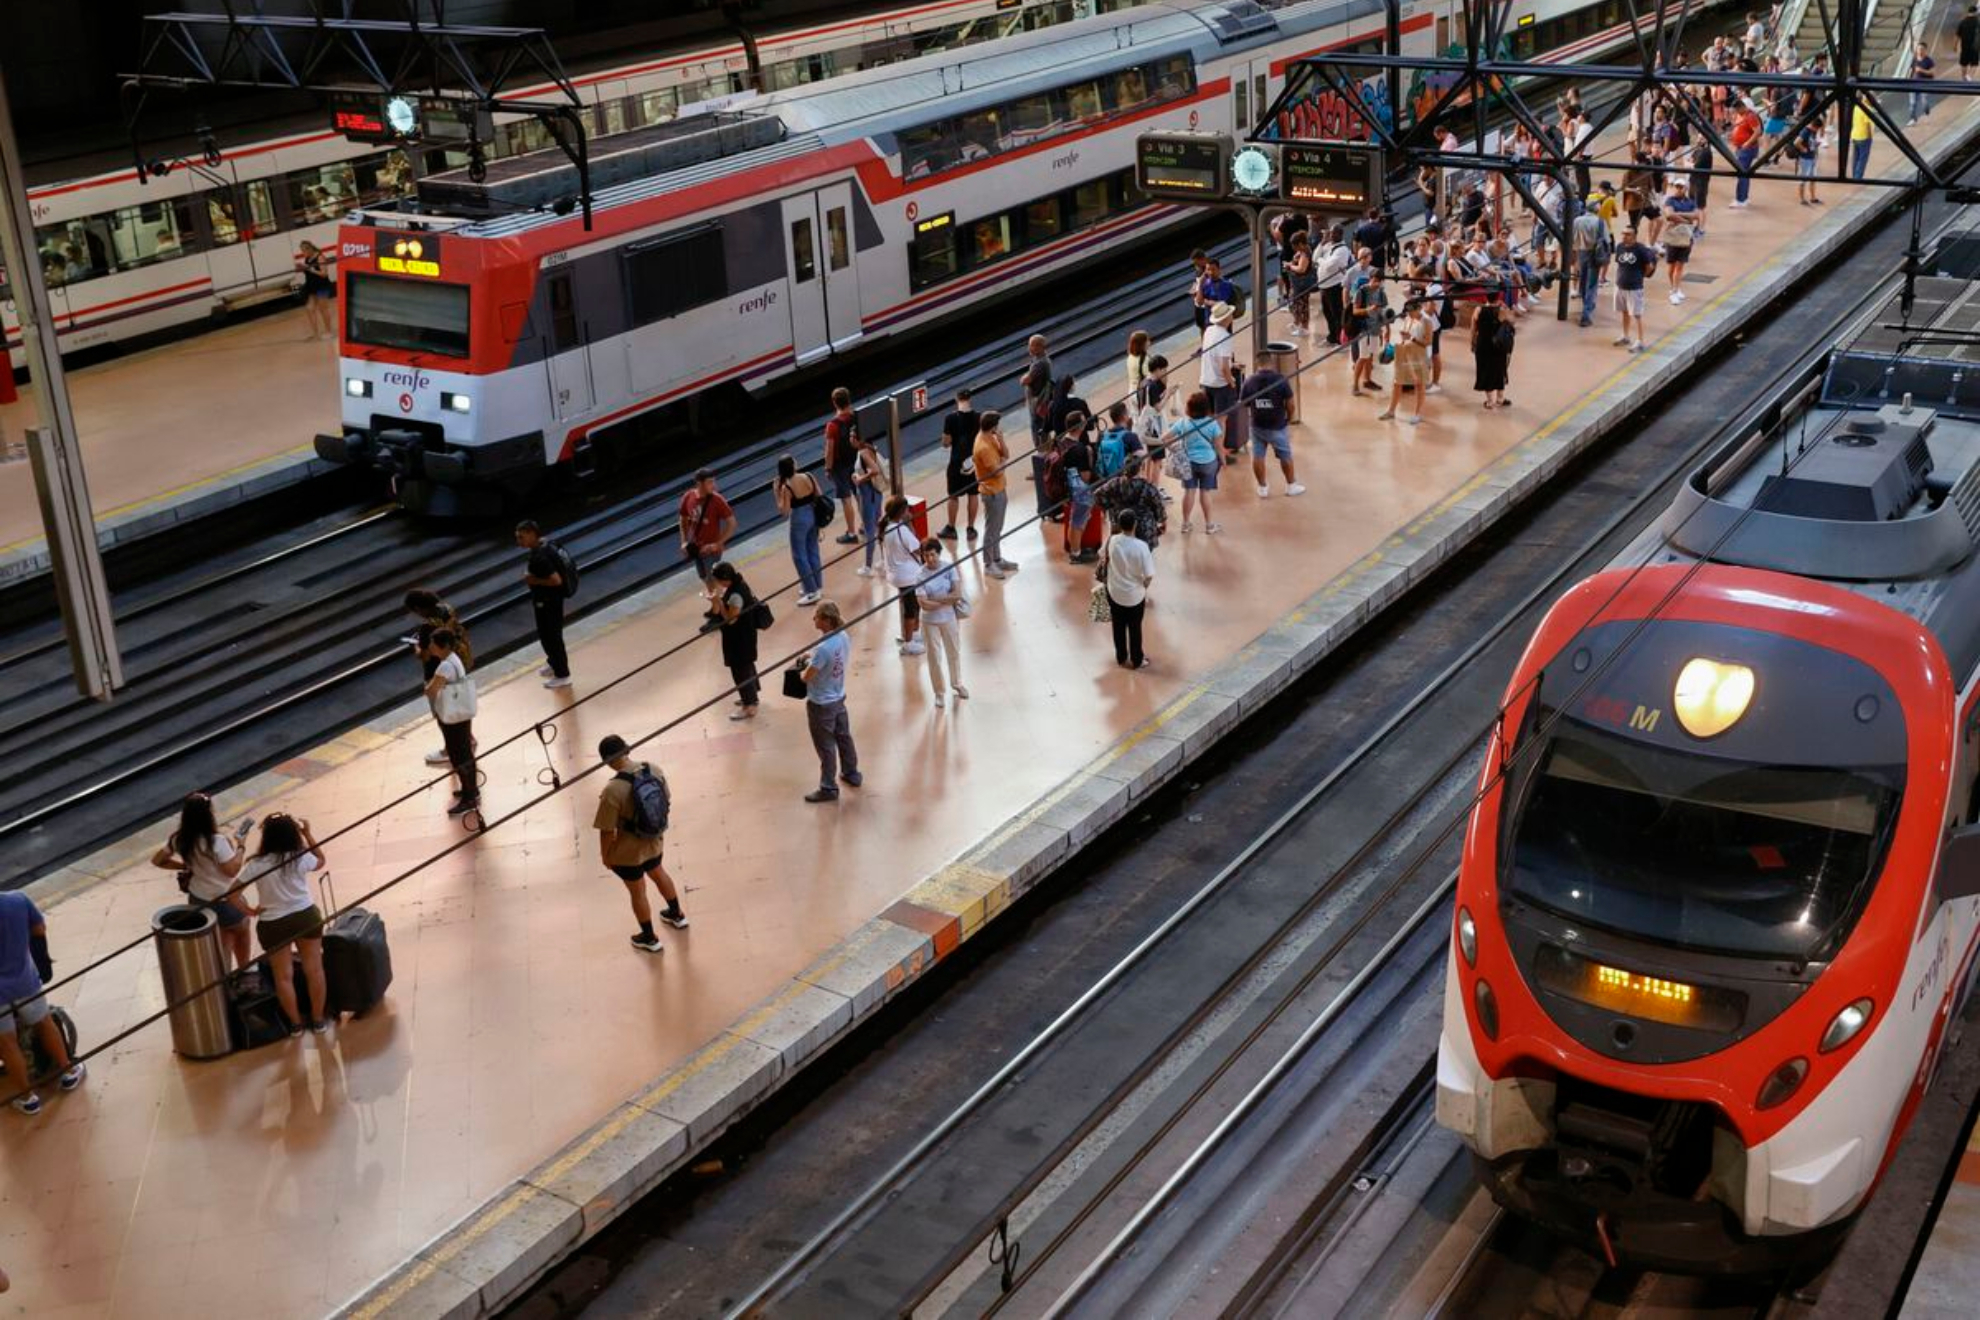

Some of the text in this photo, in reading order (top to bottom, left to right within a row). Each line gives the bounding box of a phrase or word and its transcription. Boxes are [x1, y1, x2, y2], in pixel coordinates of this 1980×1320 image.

[1052, 149, 1079, 169] renfe
[1178, 144, 1185, 154] 3
[1303, 151, 1331, 163] Via 4
[739, 289, 776, 314] renfe
[384, 369, 430, 392] renfe
[1629, 704, 1661, 732] M
[1911, 936, 1948, 1012] renfe
